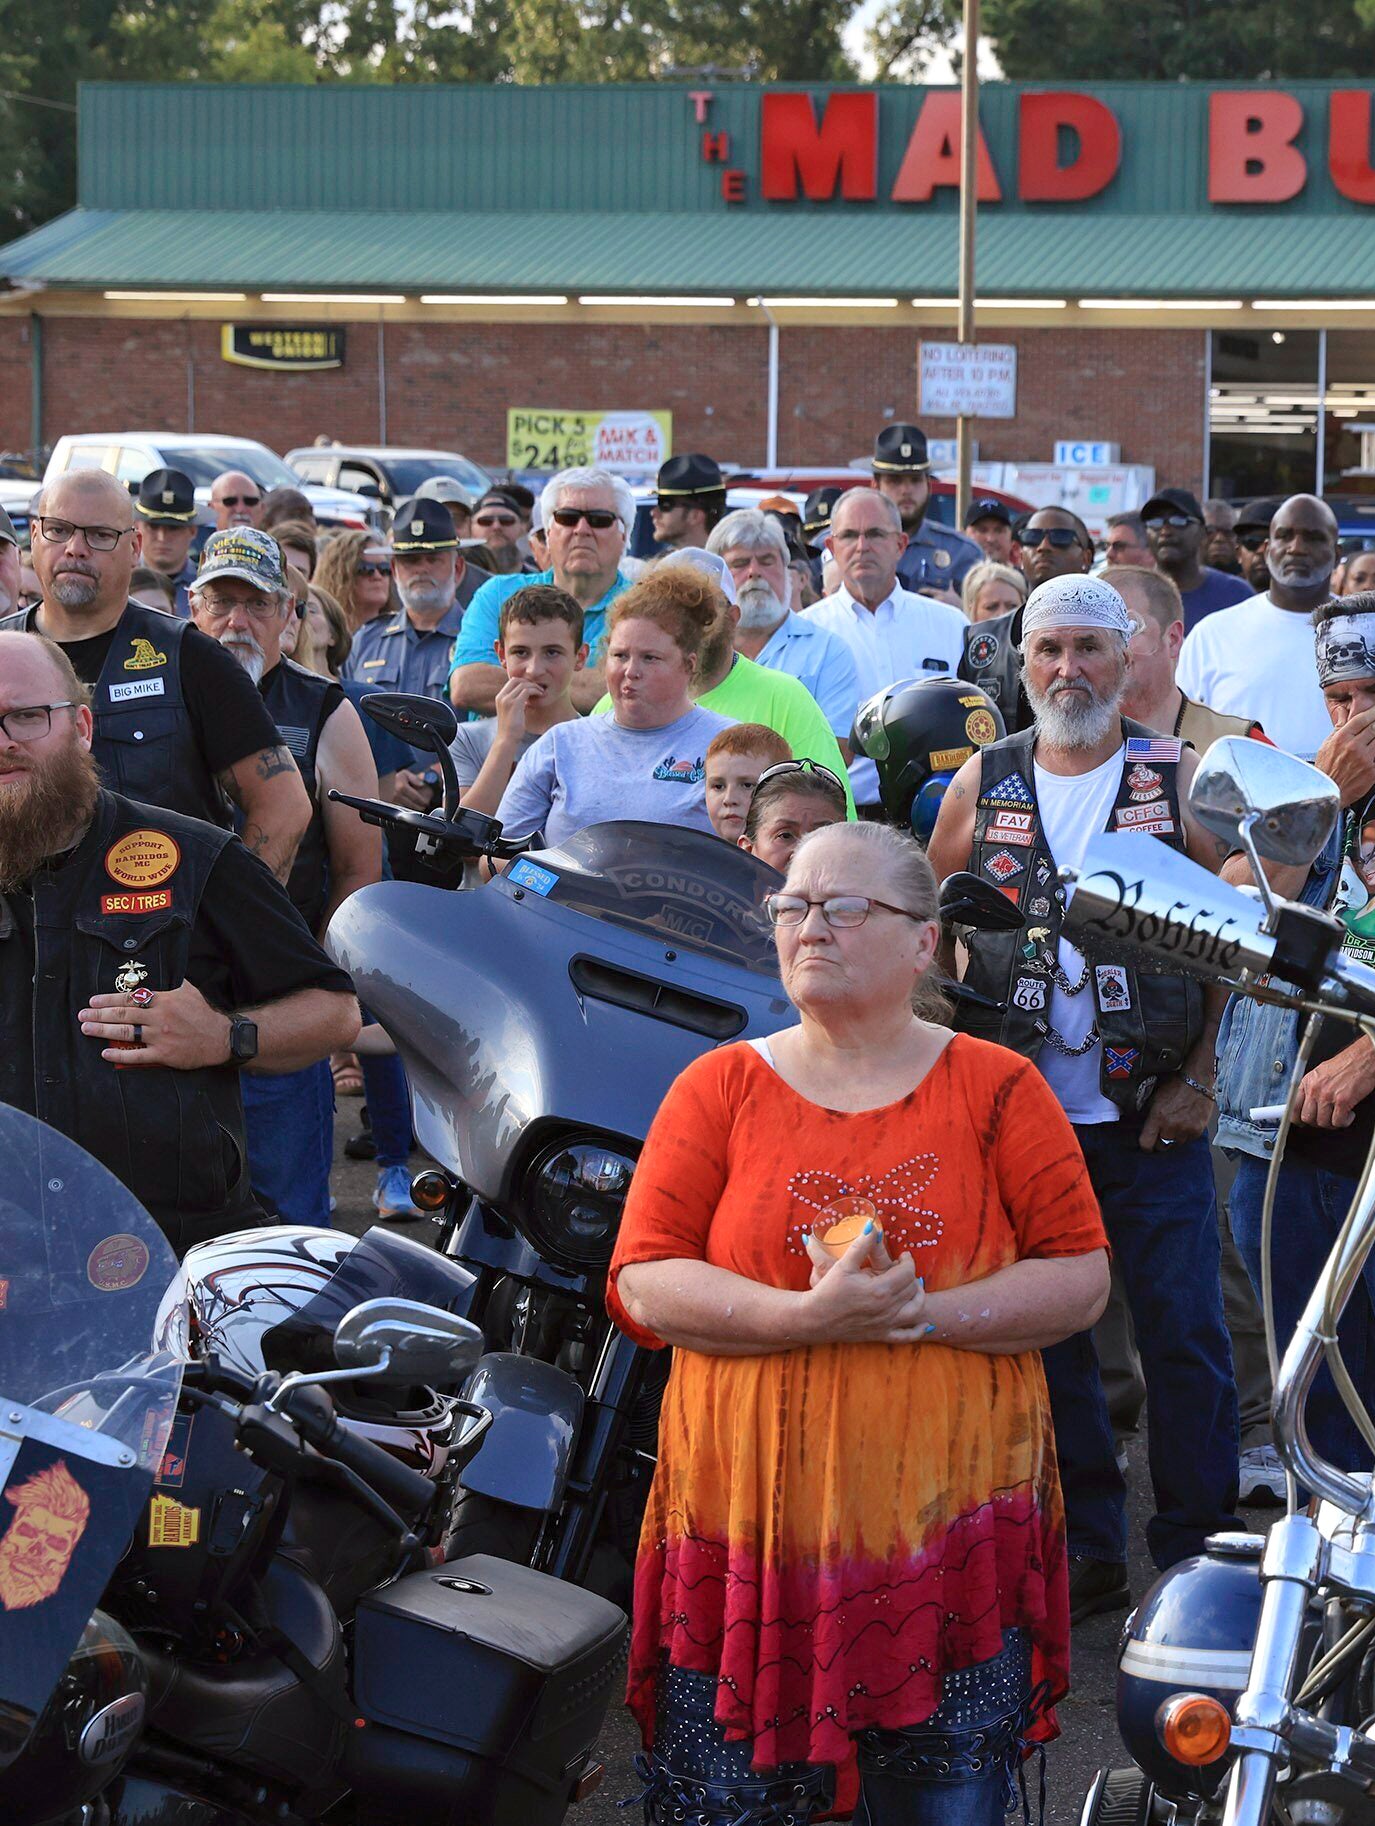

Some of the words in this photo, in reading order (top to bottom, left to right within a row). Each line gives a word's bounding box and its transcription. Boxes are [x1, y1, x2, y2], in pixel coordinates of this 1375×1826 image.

[688, 91, 747, 202] THE
[761, 90, 1121, 203] MAD
[249, 331, 326, 346] WESTERN
[271, 344, 326, 358] UNION
[515, 416, 564, 435] PICK
[574, 417, 586, 436] 5
[598, 449, 659, 464] MATCH
[1059, 443, 1105, 464] ICE
[113, 687, 132, 698] BIG
[133, 682, 160, 694] MIKE
[990, 799, 1034, 811] MEMORIAM
[999, 814, 1028, 827] FAY
[1123, 804, 1164, 822] CFFC
[1129, 823, 1163, 833] COFFEE
[1000, 832, 1031, 843] VETERAN
[119, 841, 164, 854] SUPPORT
[115, 853, 169, 864] BANDIDOS
[114, 867, 146, 882] WORLD
[147, 863, 173, 881] WIDE
[665, 912, 707, 939] M/C
[1019, 979, 1045, 989] ROUTE
[1018, 987, 1040, 1008] 66
[163, 1505, 181, 1543] BANDIDOS
